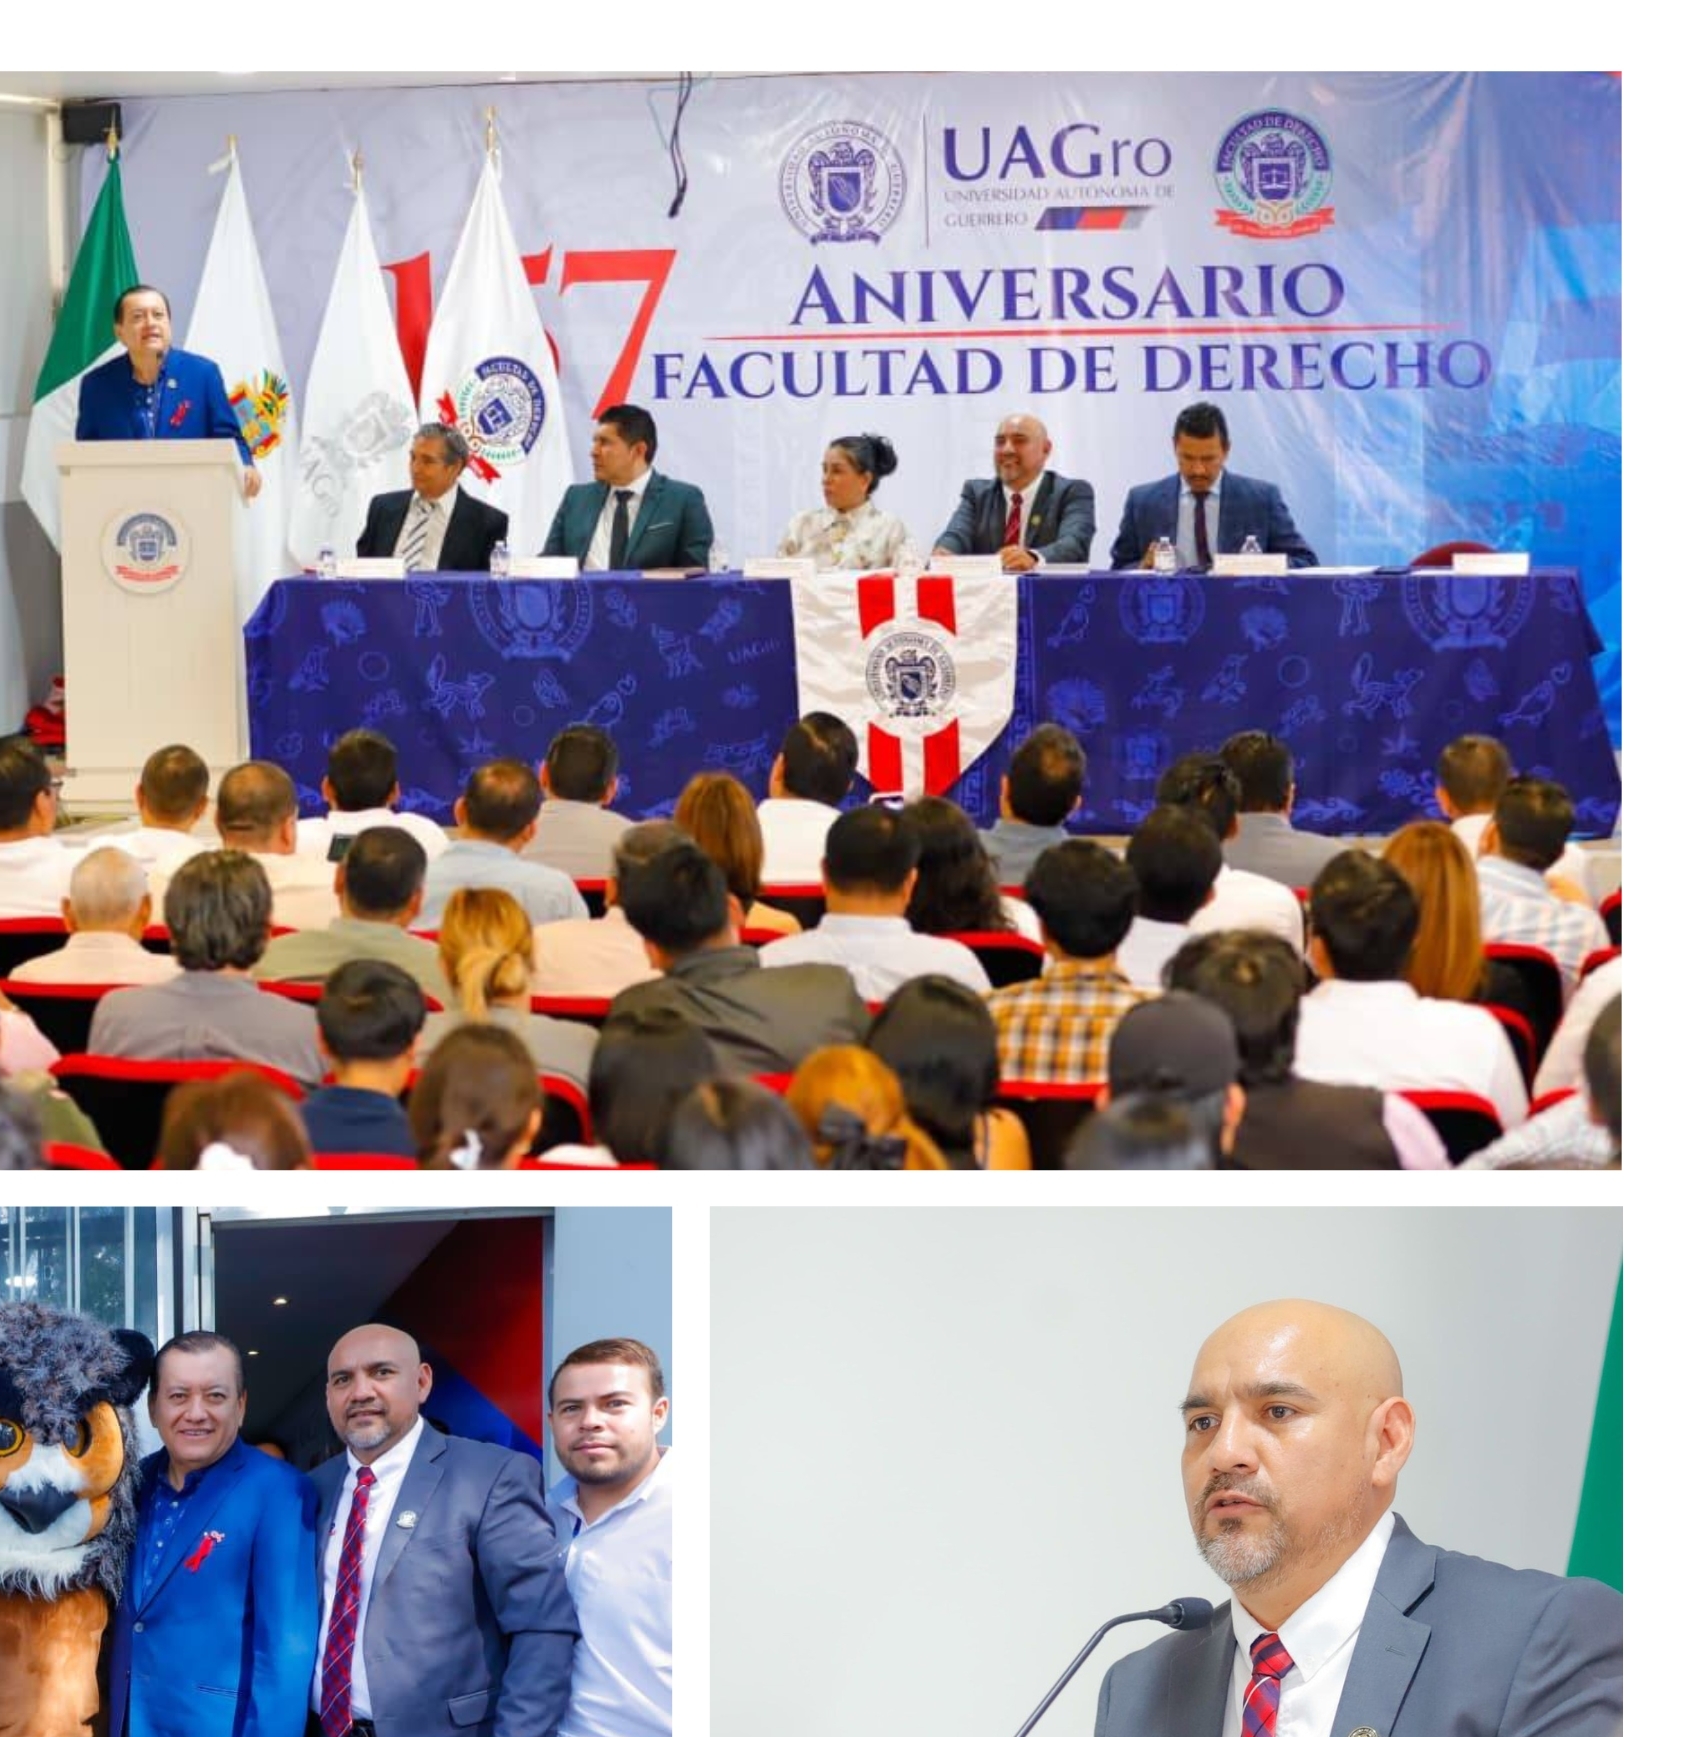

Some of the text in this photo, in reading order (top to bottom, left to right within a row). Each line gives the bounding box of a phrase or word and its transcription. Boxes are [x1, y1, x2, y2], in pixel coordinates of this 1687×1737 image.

[944, 124, 1172, 181] UAGro
[944, 211, 1028, 227] GUERRERO
[945, 187, 1050, 202] UNIVERSIDAD
[1156, 183, 1175, 198] DE
[789, 262, 1345, 326] ANIVERSARIO
[652, 339, 1493, 400] FACULTAD DE DERECHO
